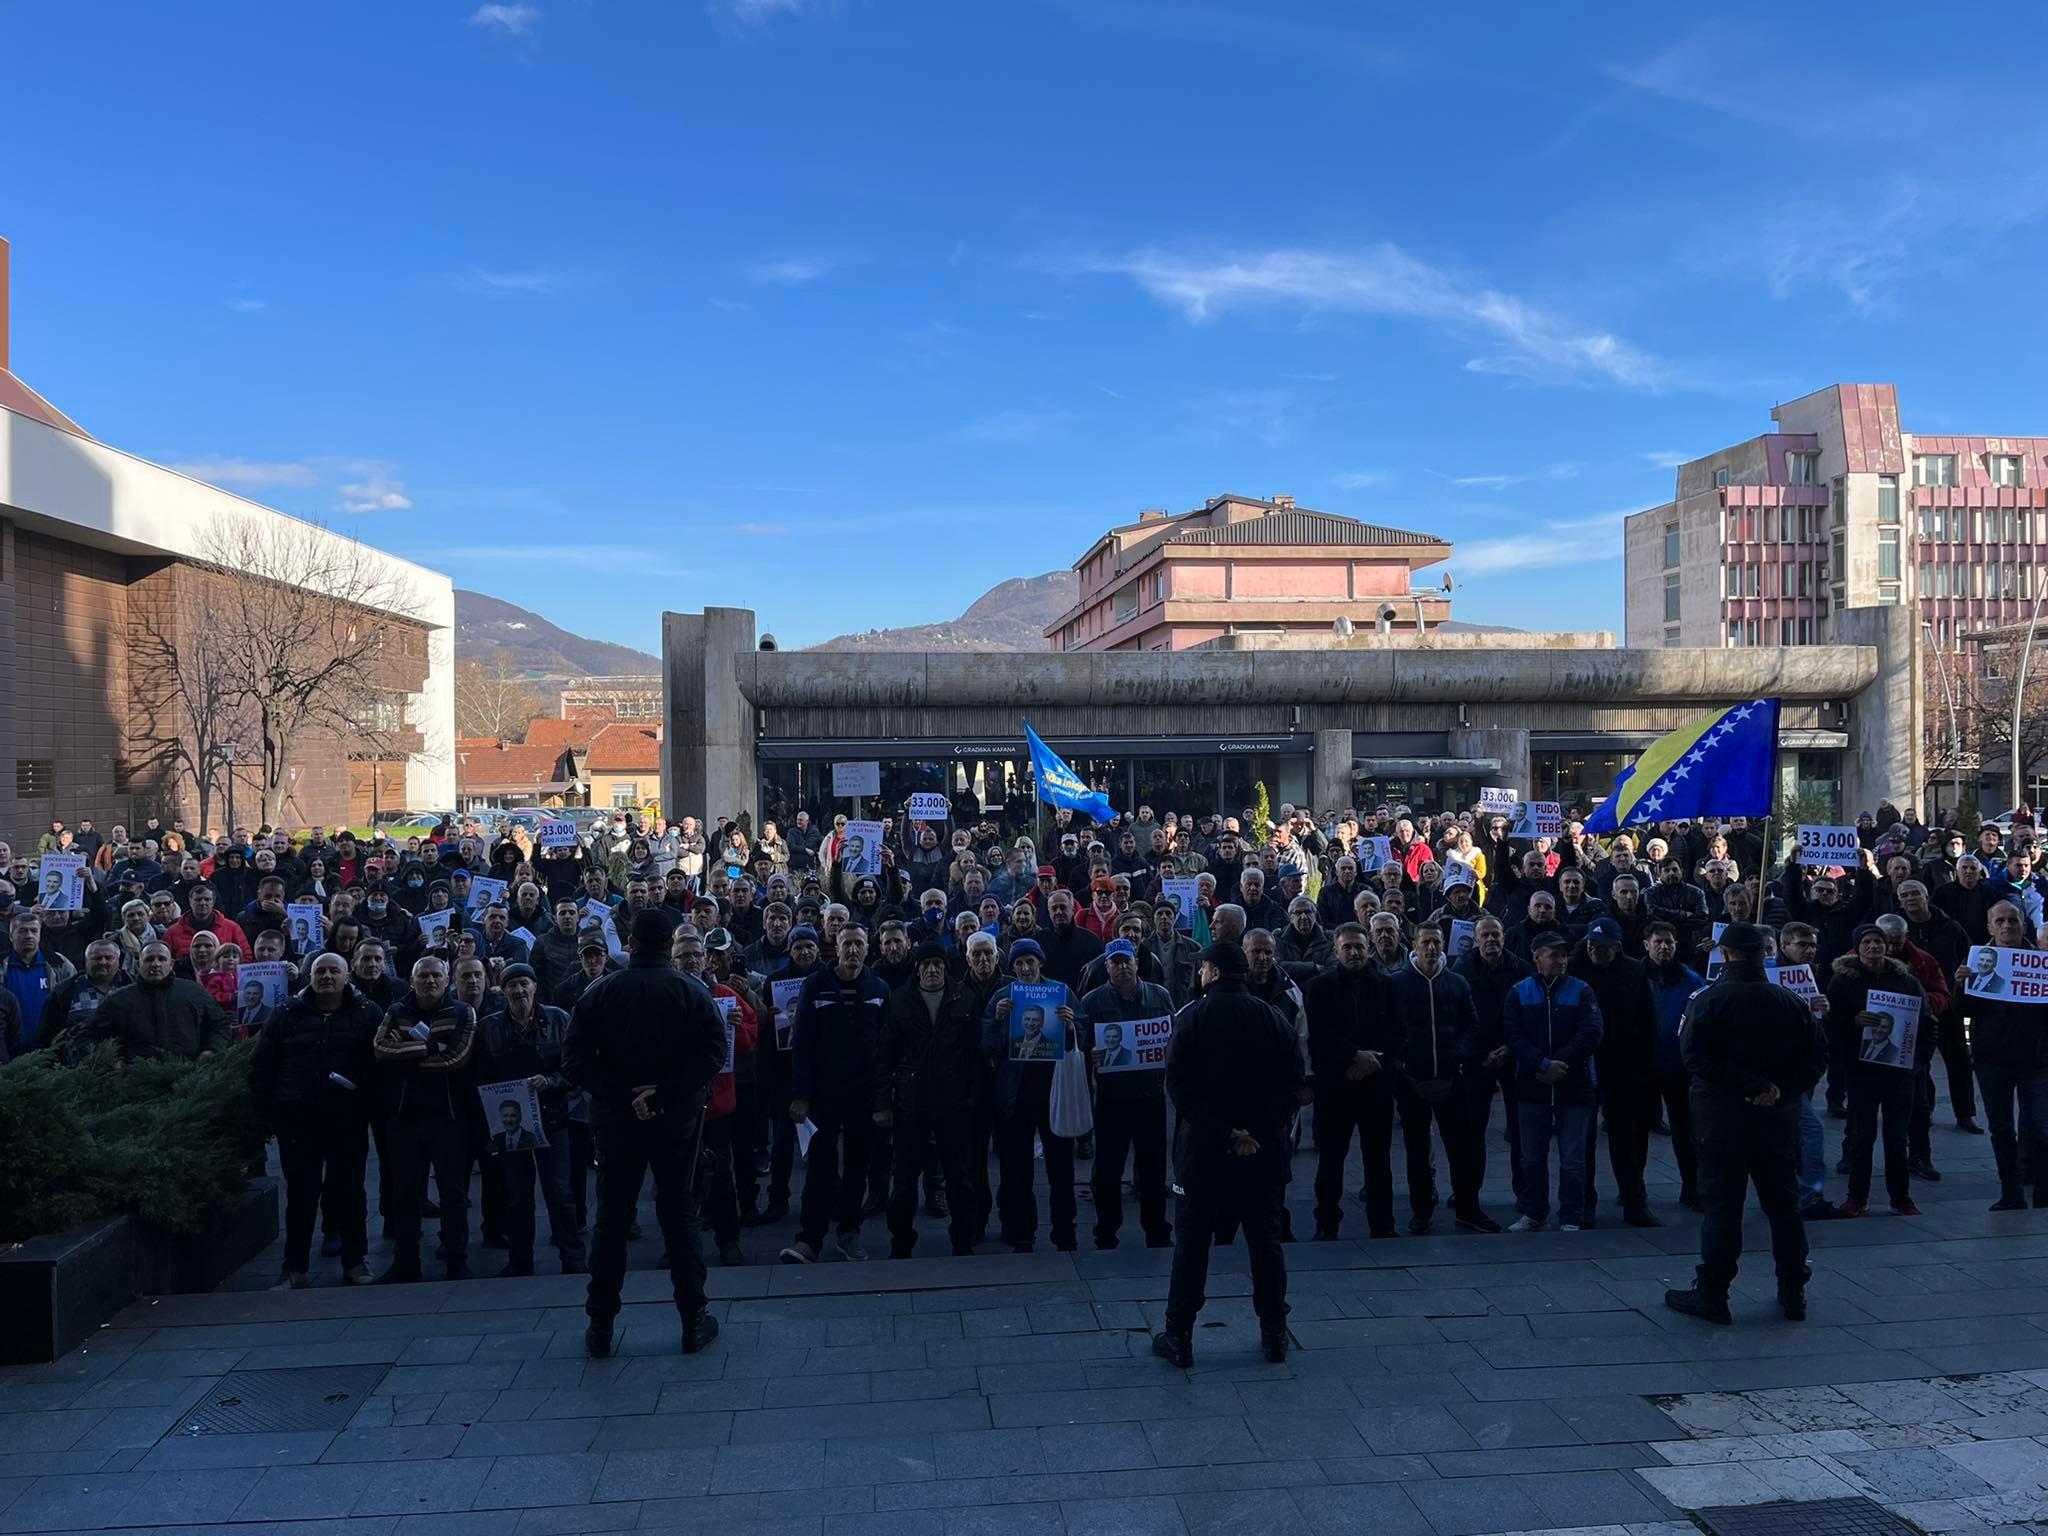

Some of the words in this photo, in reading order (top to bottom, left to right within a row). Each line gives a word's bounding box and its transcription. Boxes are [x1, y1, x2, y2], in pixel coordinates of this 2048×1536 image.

[911, 797, 945, 808] 33.000
[1482, 791, 1515, 803] 33.000
[1535, 804, 1560, 814] FUDO
[542, 825, 574, 836] 33.000
[1535, 822, 1561, 833] TEBE
[1801, 831, 1855, 848] 33.000
[1799, 850, 1820, 859] FUDO
[1821, 851, 1829, 859] JE
[1830, 851, 1857, 860] ZENICA
[1014, 984, 1060, 993] KASUMOVIĆ
[2011, 981, 2048, 997] TEBE
[1871, 993, 1896, 1003] LAŠVA
[1135, 1020, 1169, 1036] FUDO
